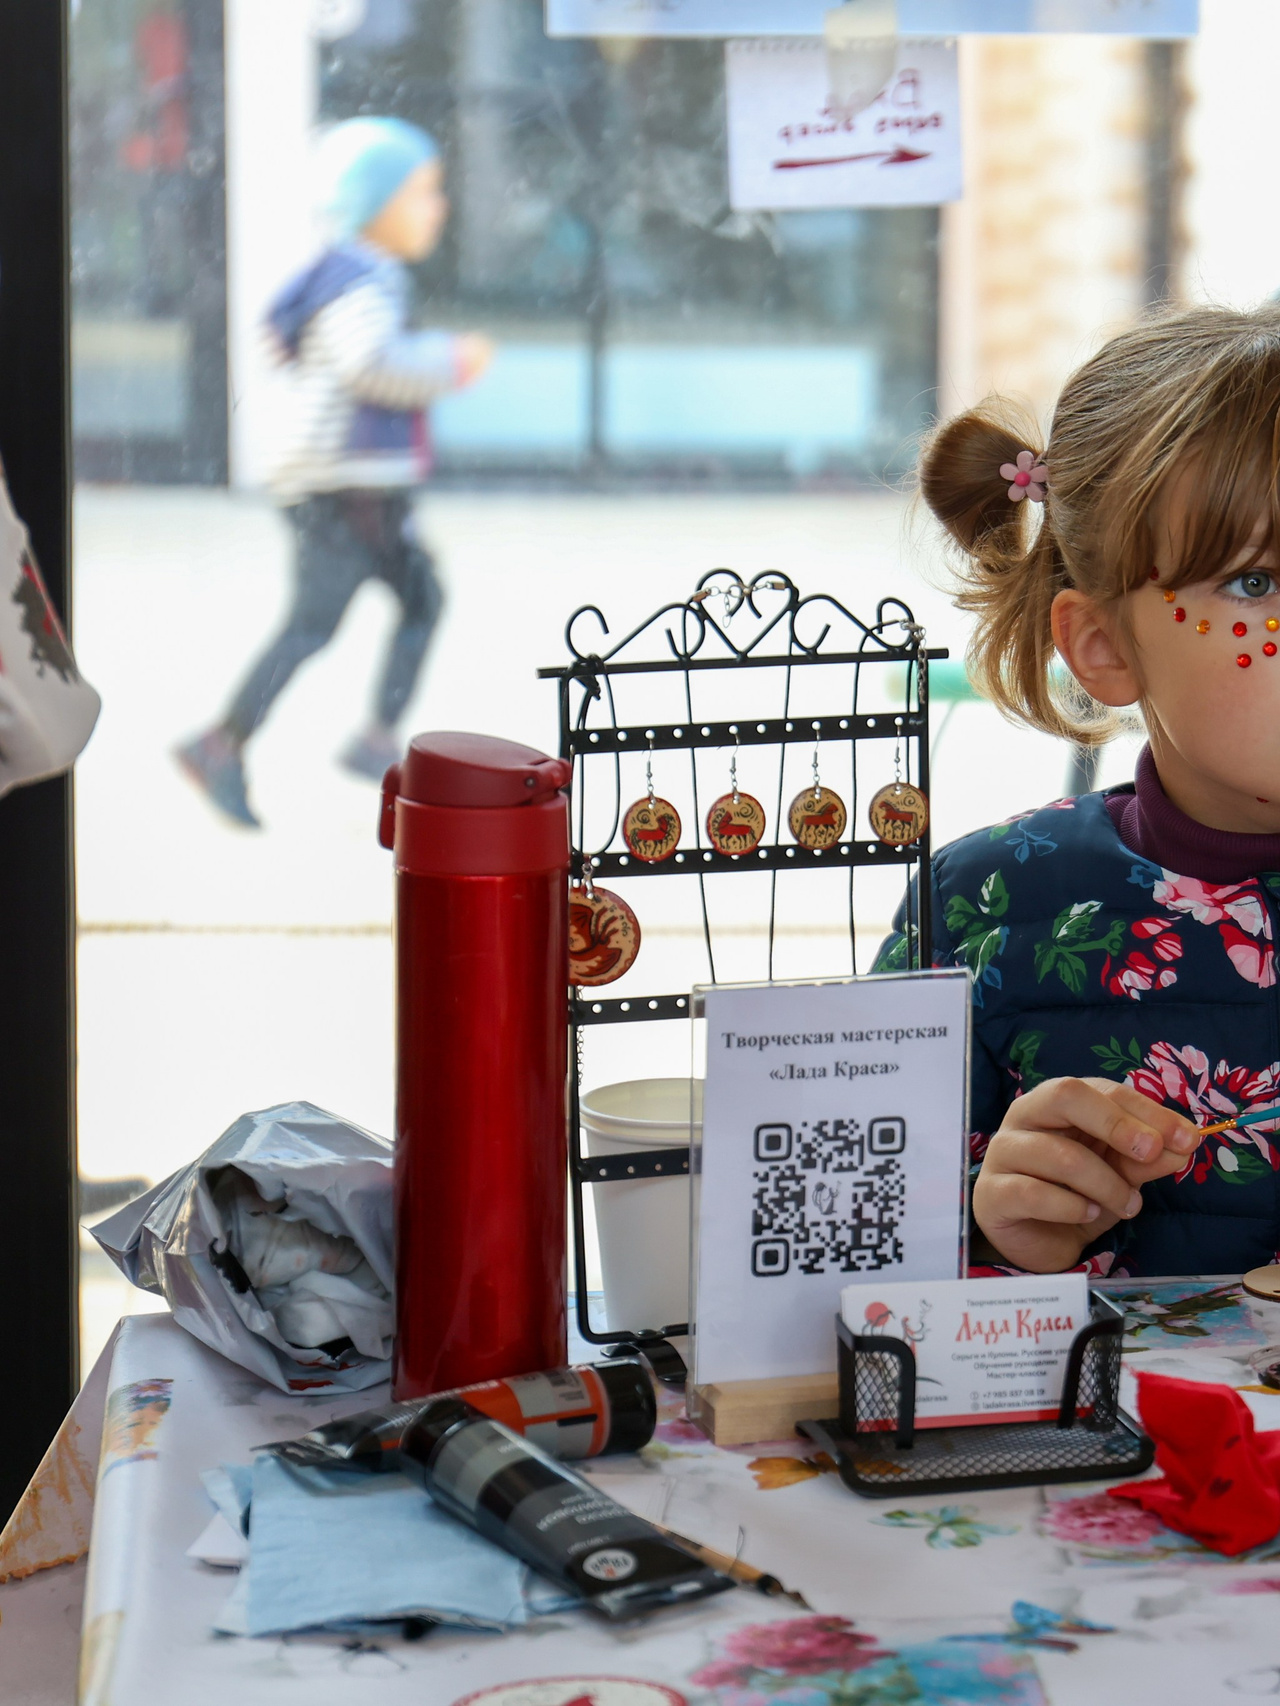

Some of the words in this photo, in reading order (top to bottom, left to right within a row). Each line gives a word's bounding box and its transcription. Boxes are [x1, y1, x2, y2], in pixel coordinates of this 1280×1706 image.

[722, 1031, 834, 1051] Творческая
[841, 1025, 948, 1043] мастерская
[769, 1063, 827, 1080] «Лада
[834, 1061, 900, 1081] Краса»
[967, 1299, 1012, 1307] Творческая
[1014, 1296, 1059, 1305] мастерская
[955, 1312, 1010, 1345] Лада
[1016, 1308, 1074, 1344] Краса
